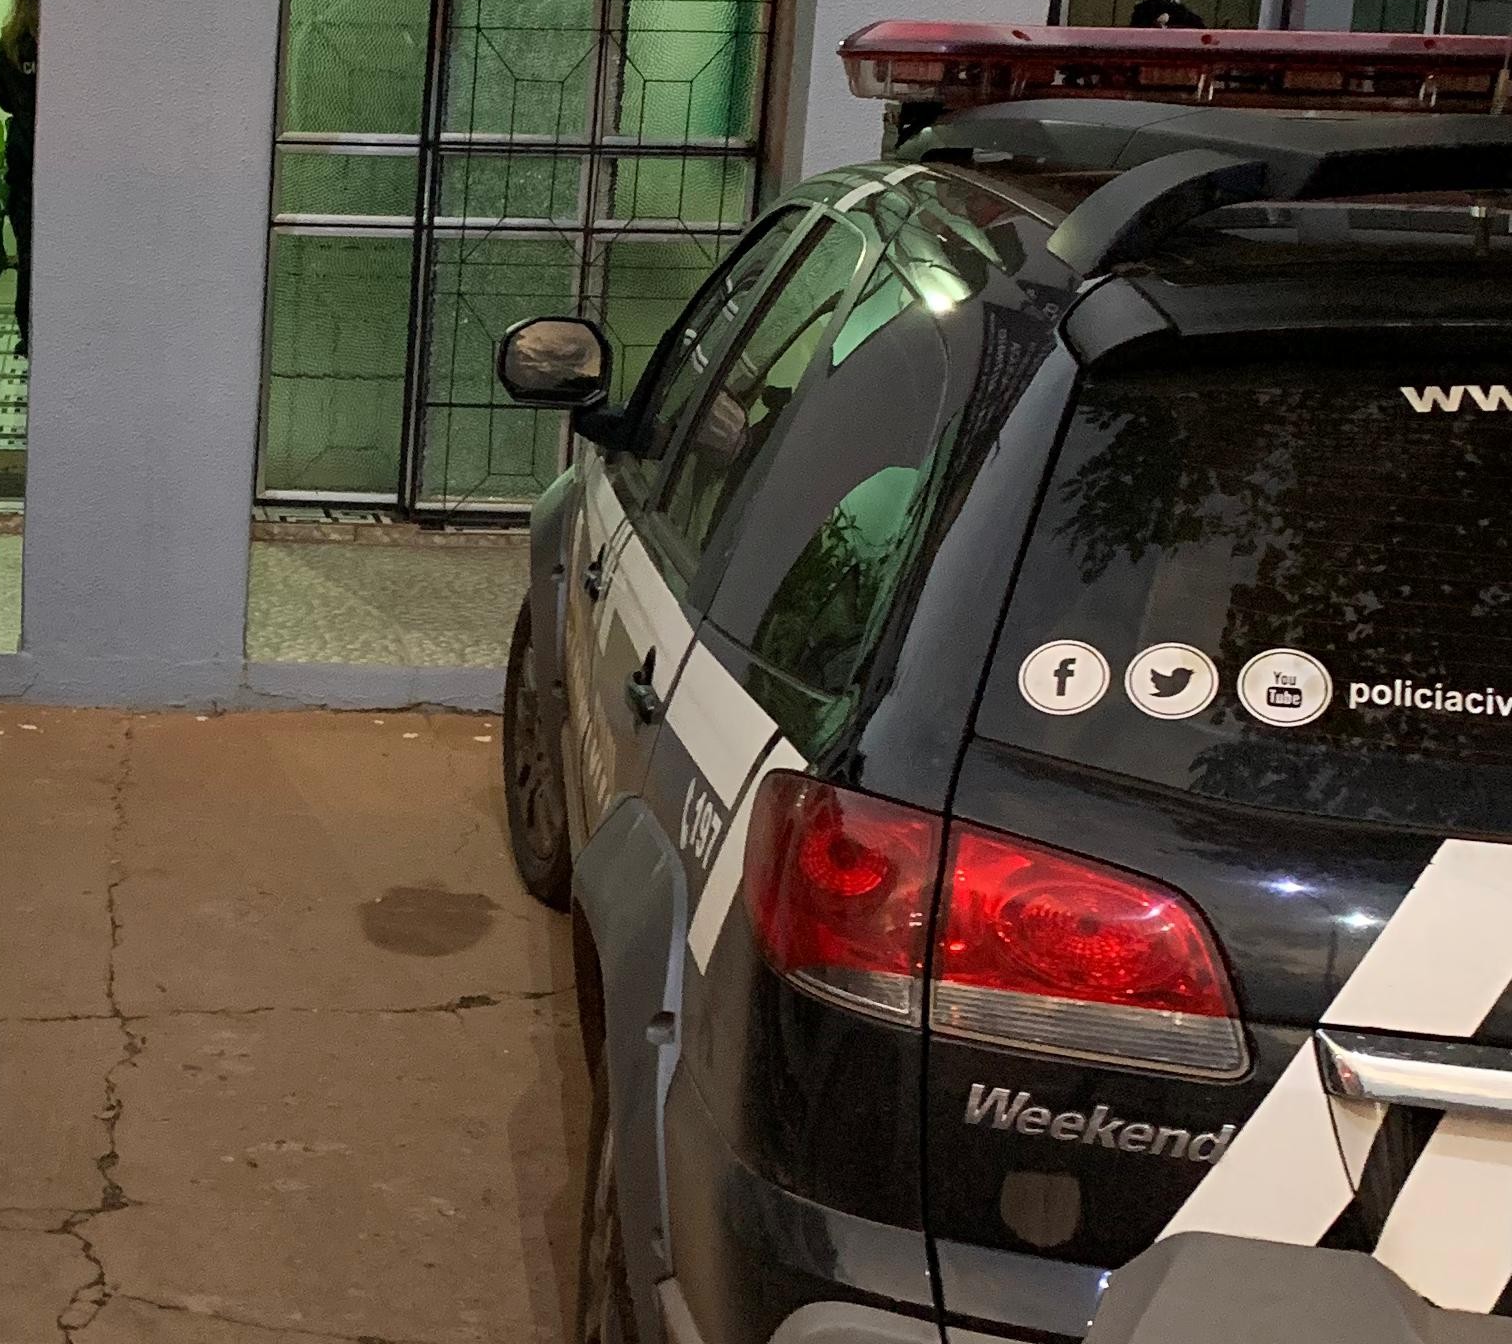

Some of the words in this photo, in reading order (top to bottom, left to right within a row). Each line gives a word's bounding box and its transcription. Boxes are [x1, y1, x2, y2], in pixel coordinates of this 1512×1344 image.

[1273, 670, 1297, 686] You
[1268, 687, 1302, 706] Tube
[964, 1082, 1238, 1165] Weekend
